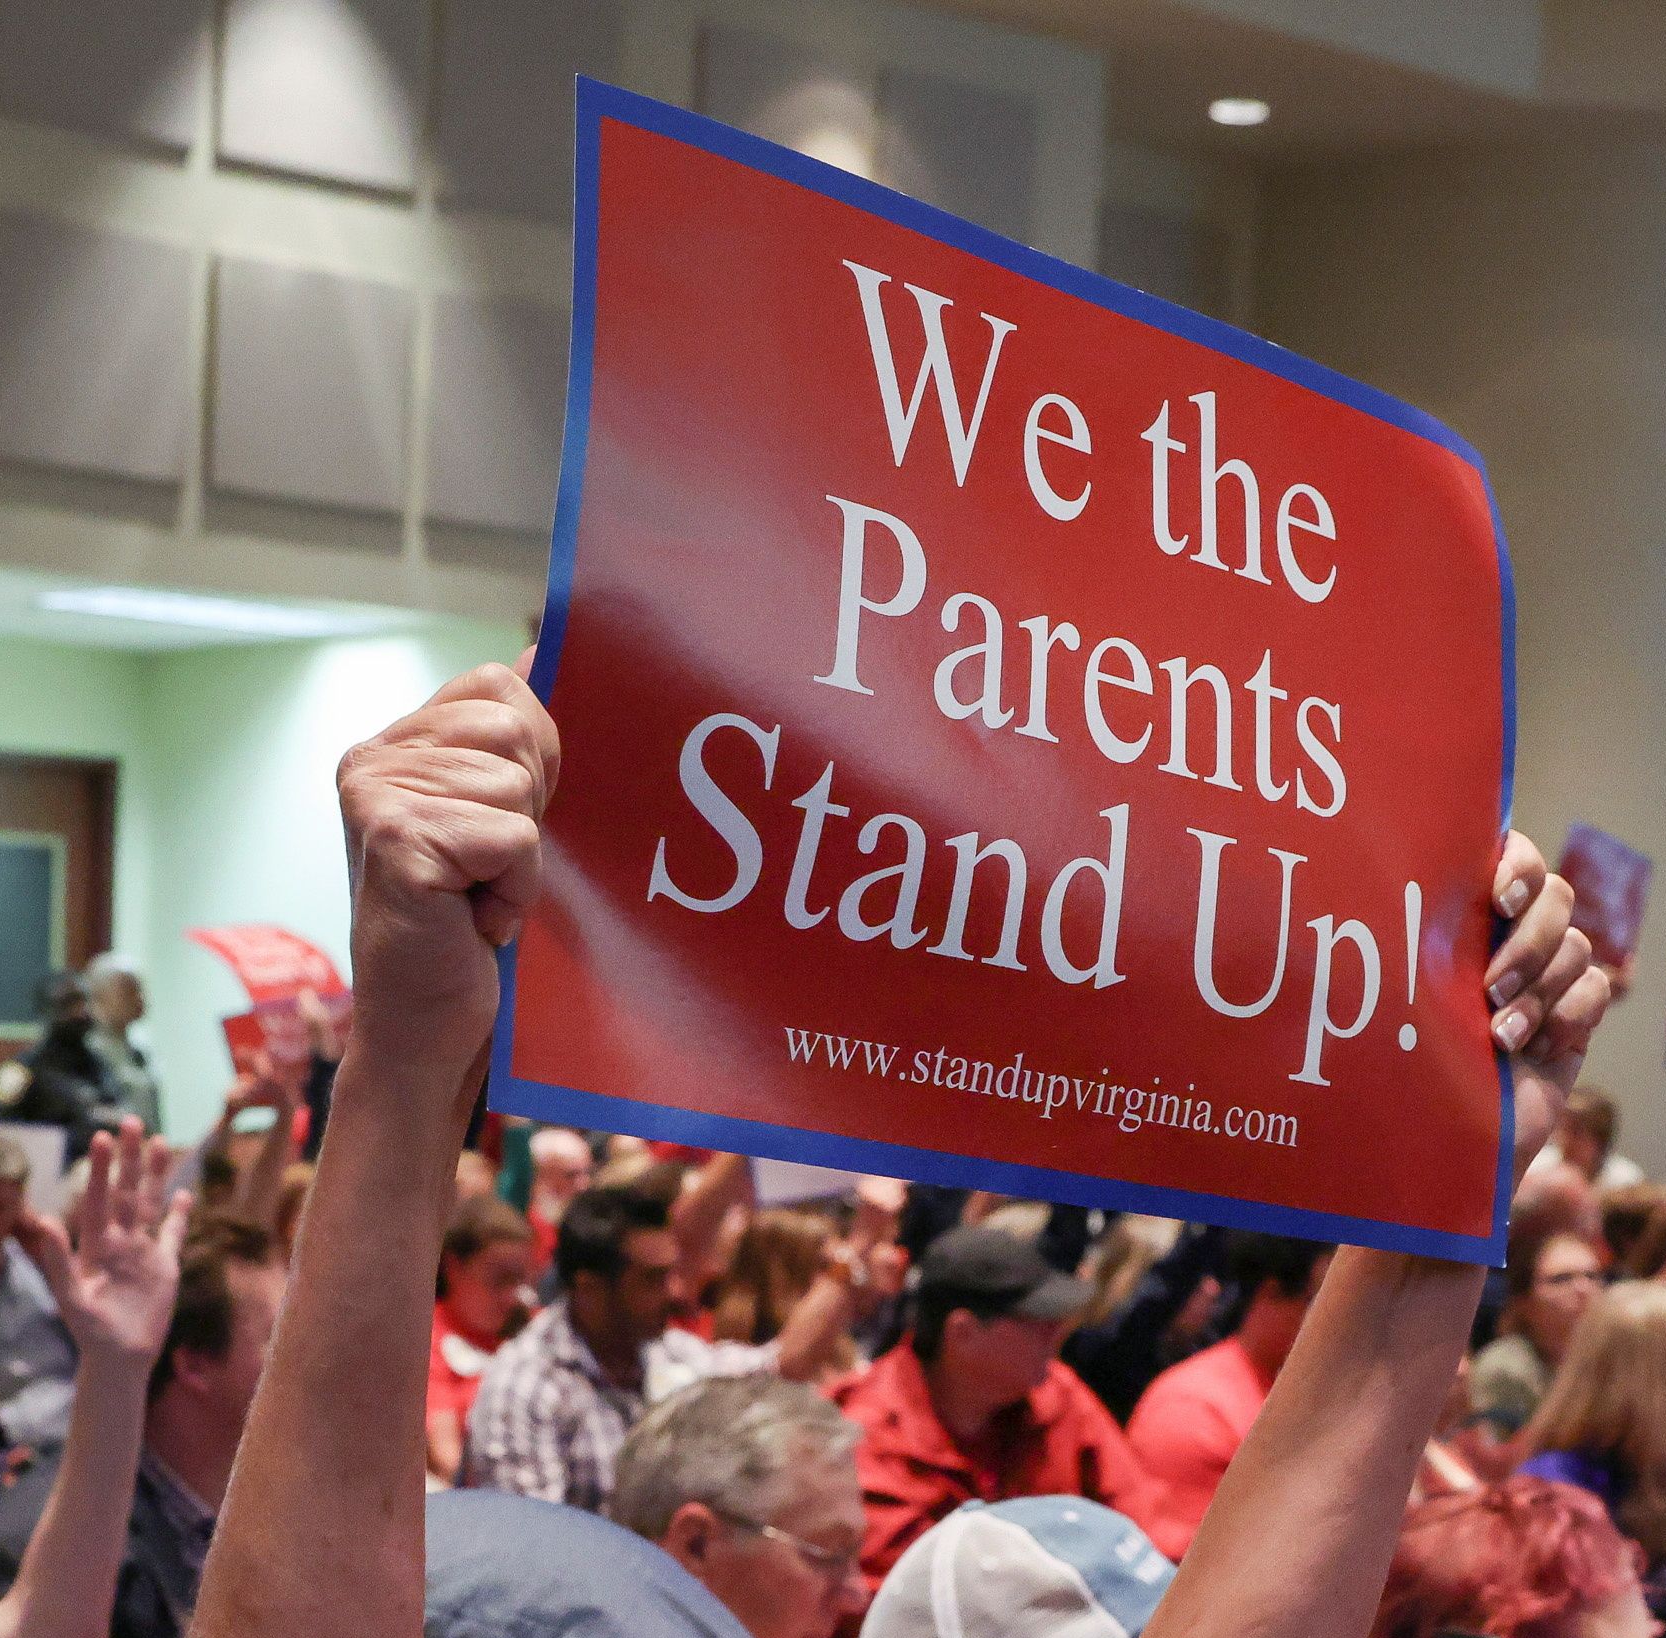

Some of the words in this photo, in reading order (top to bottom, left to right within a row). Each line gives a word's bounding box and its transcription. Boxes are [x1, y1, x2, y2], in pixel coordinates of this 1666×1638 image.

[842, 259, 1092, 522] We
[1140, 391, 1337, 603] the
[813, 494, 1347, 818] Parents
[647, 713, 1130, 990] Stand
[1186, 827, 1422, 1087] Up!
[783, 1026, 1299, 1147] www.standupvirginia.com
